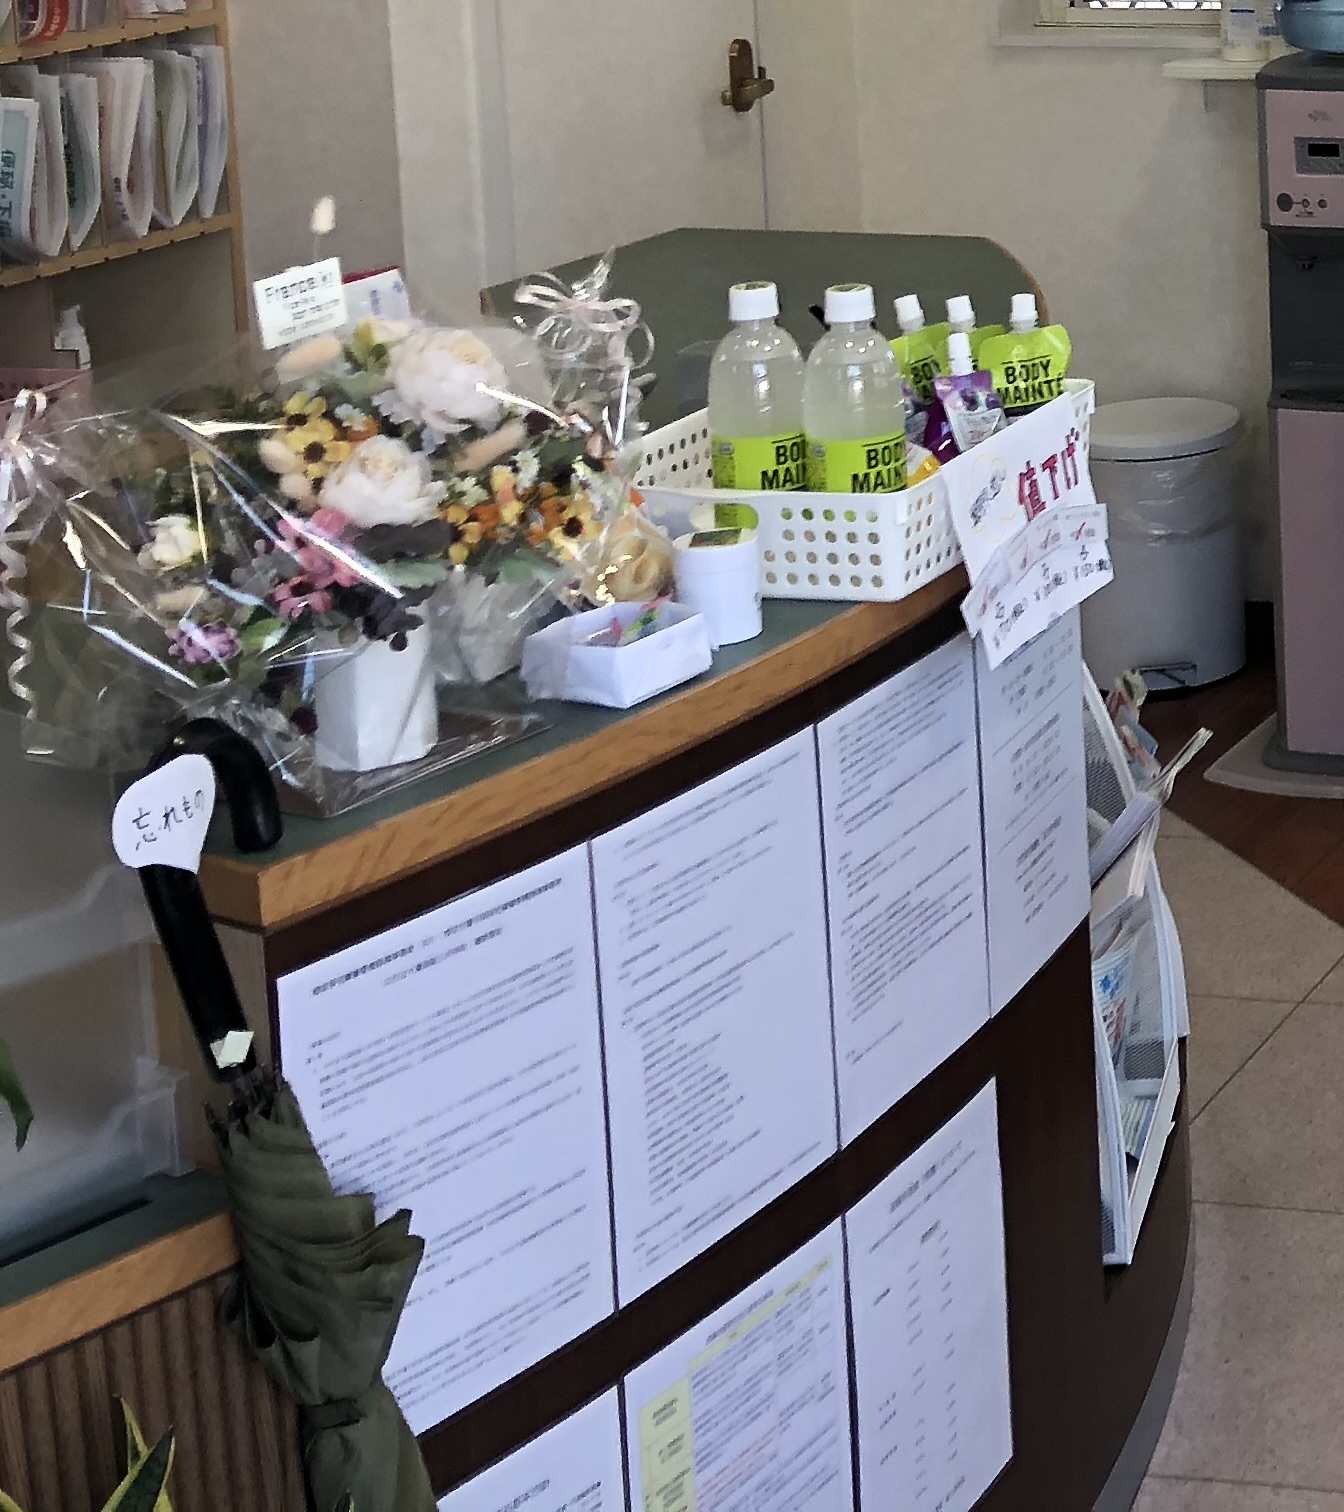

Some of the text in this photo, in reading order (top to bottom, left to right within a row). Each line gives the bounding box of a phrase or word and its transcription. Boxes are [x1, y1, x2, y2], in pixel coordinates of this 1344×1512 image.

[1004, 360, 1051, 383] BODY
[775, 443, 805, 467] BO
[866, 443, 905, 469] BOD
[761, 467, 805, 490] MAI
[851, 469, 905, 493] MAIN
